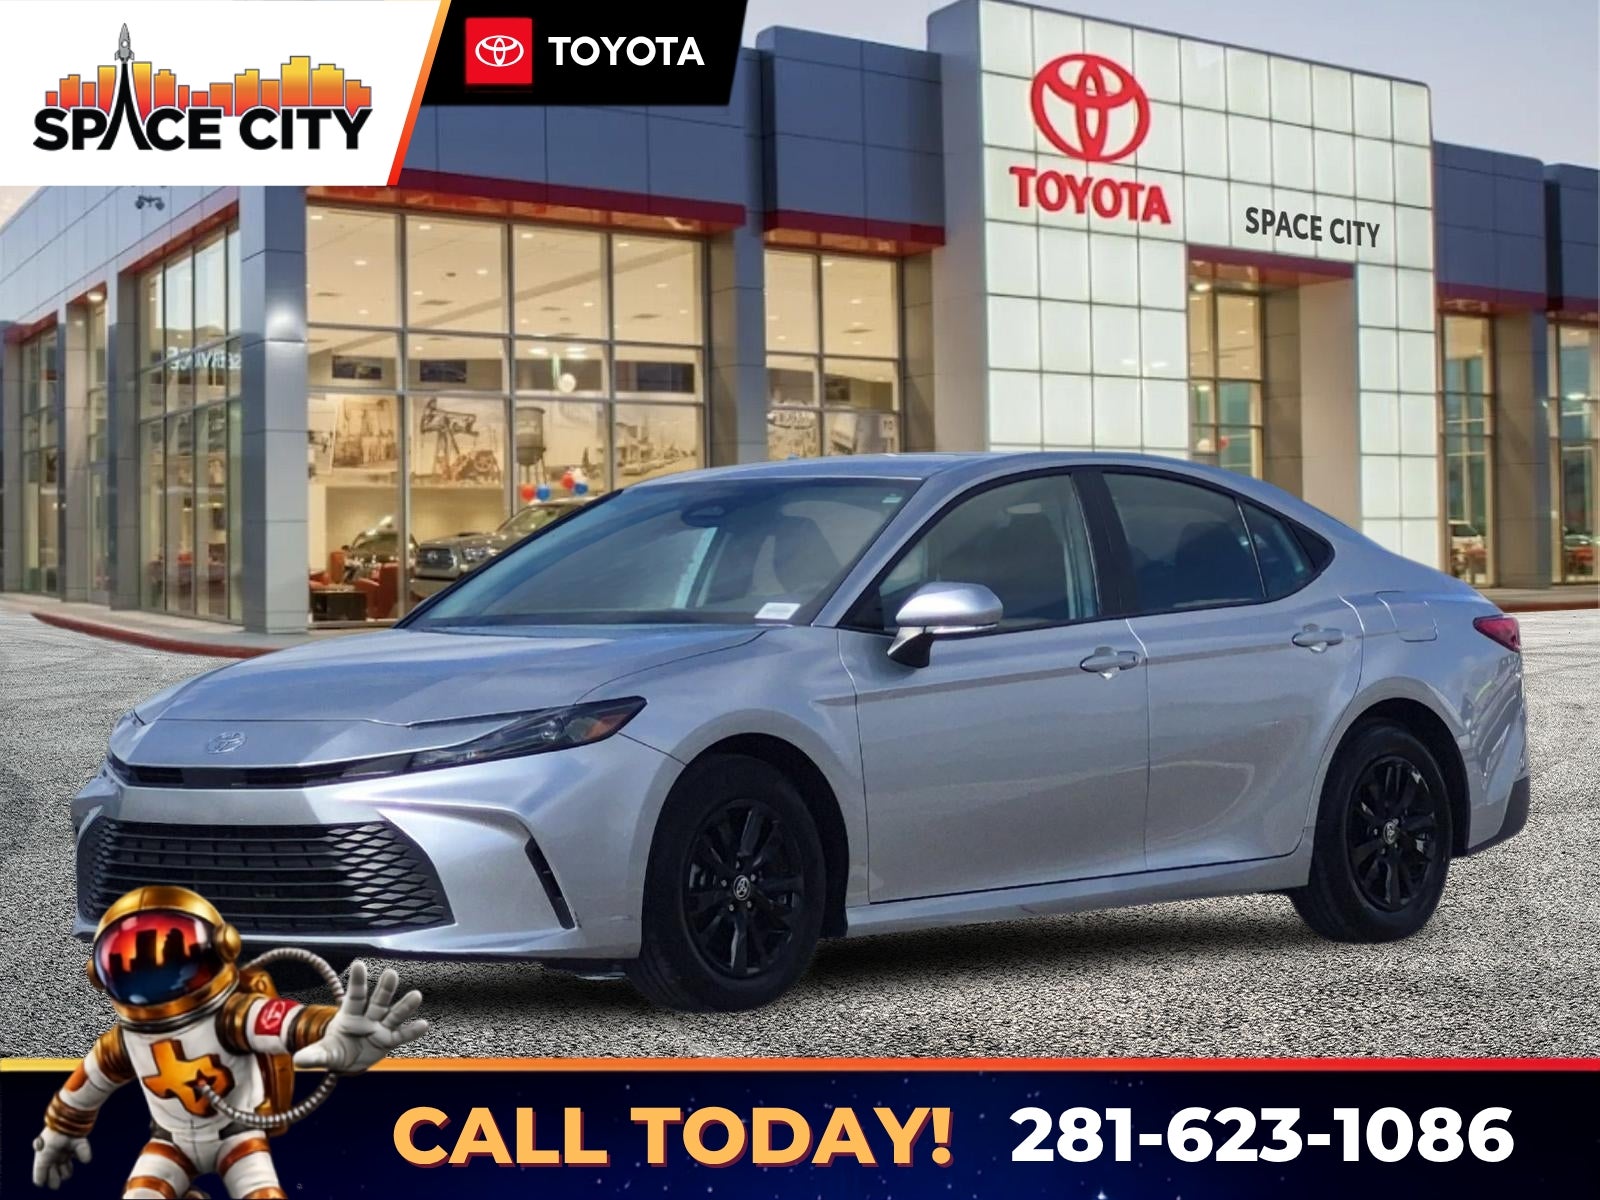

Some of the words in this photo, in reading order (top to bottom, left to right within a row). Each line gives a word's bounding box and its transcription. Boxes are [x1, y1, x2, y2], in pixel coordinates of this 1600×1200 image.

[1009, 166, 1171, 224] TOYOTA
[1245, 206, 1323, 242] SPACE
[1329, 218, 1381, 248] CITY
